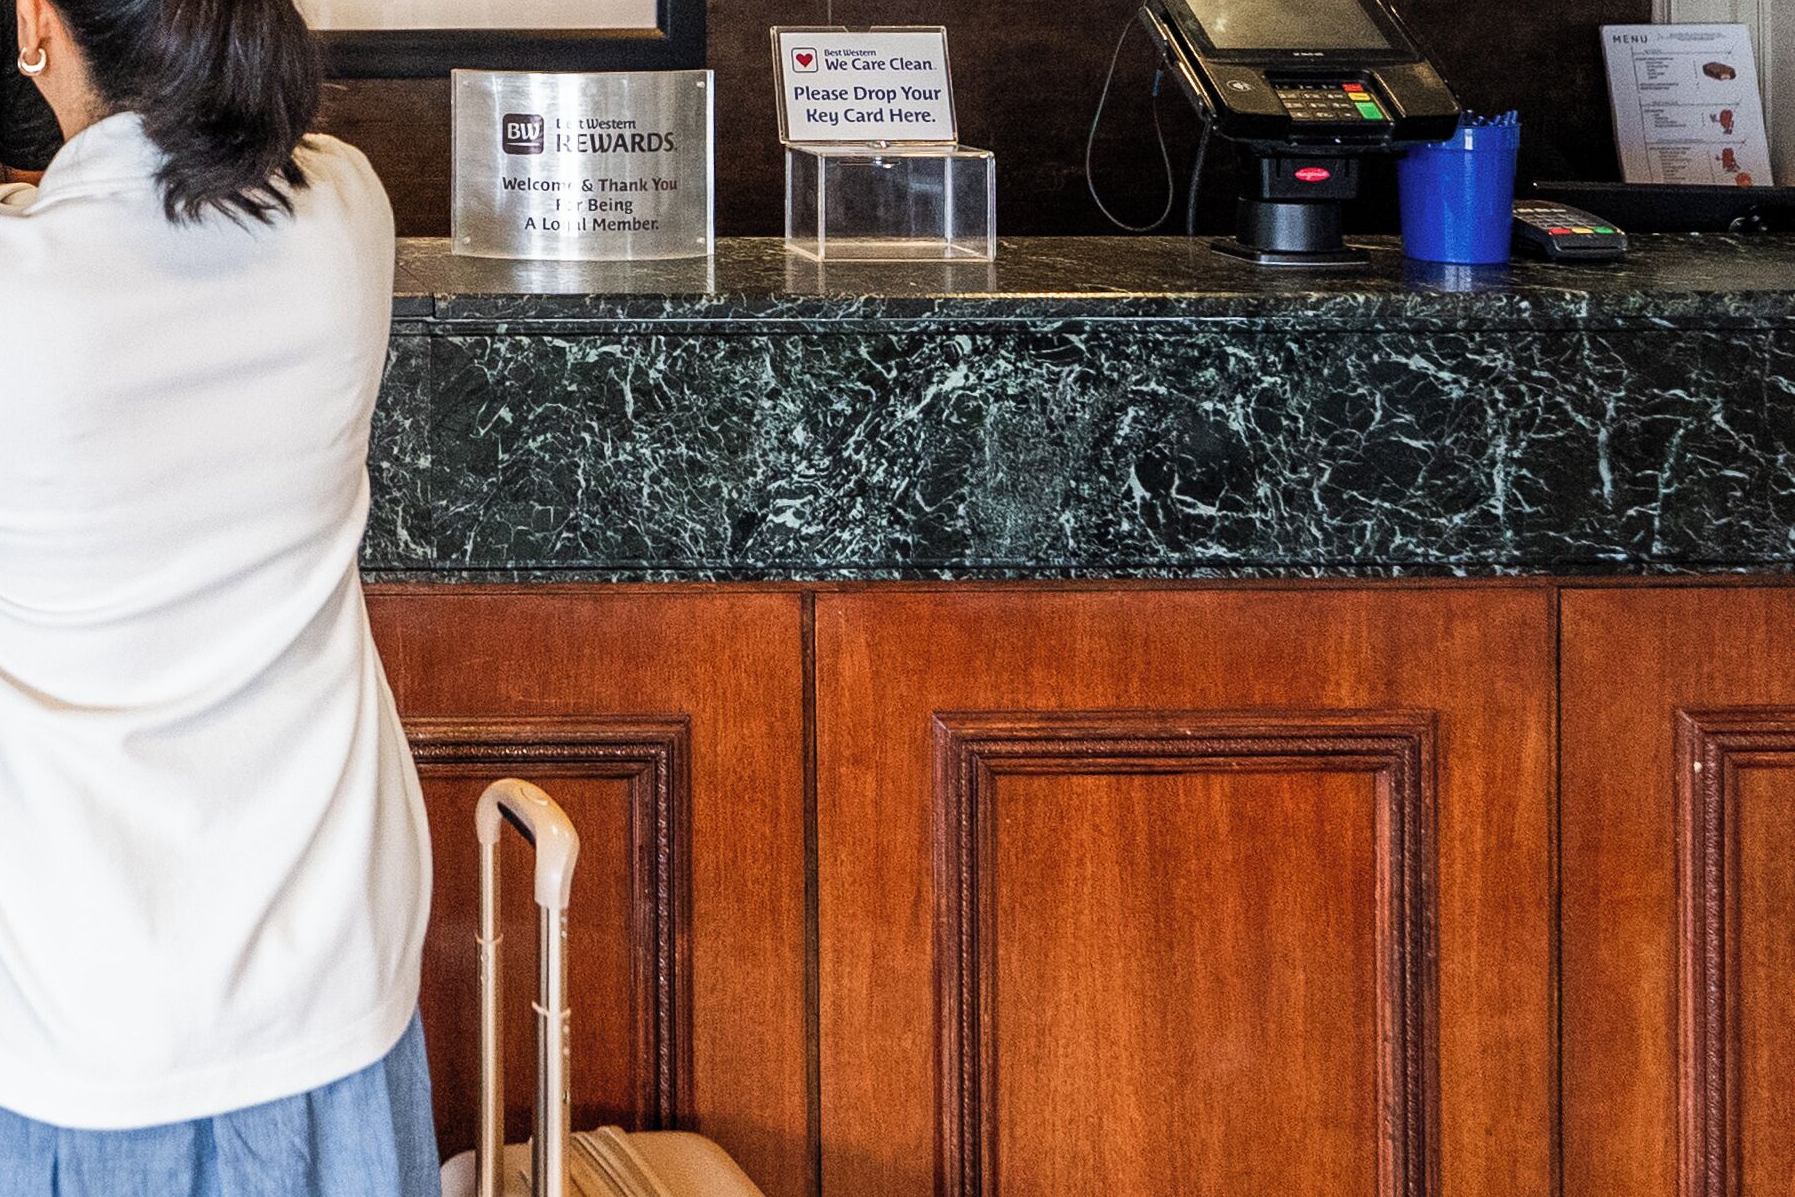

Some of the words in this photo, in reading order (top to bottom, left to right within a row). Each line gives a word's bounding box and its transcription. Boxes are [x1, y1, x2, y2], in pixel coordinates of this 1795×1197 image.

[1612, 34, 1648, 44] MENU
[824, 49, 842, 57] Best
[843, 49, 877, 57] Western
[825, 58, 848, 70] We
[852, 58, 886, 71] Care
[794, 86, 848, 101] Please
[854, 86, 897, 103] Drop
[901, 86, 941, 100] Your
[586, 118, 636, 130] Western
[806, 108, 839, 126] Key
[844, 108, 884, 123] Card
[889, 108, 936, 123] Here.
[507, 122, 541, 140] BW
[502, 177, 574, 192] Welcom
[581, 179, 593, 192] &
[598, 178, 648, 192] Thank
[652, 177, 678, 191] You
[588, 199, 633, 214] Being
[524, 217, 536, 231] A
[592, 218, 659, 232] Member.
